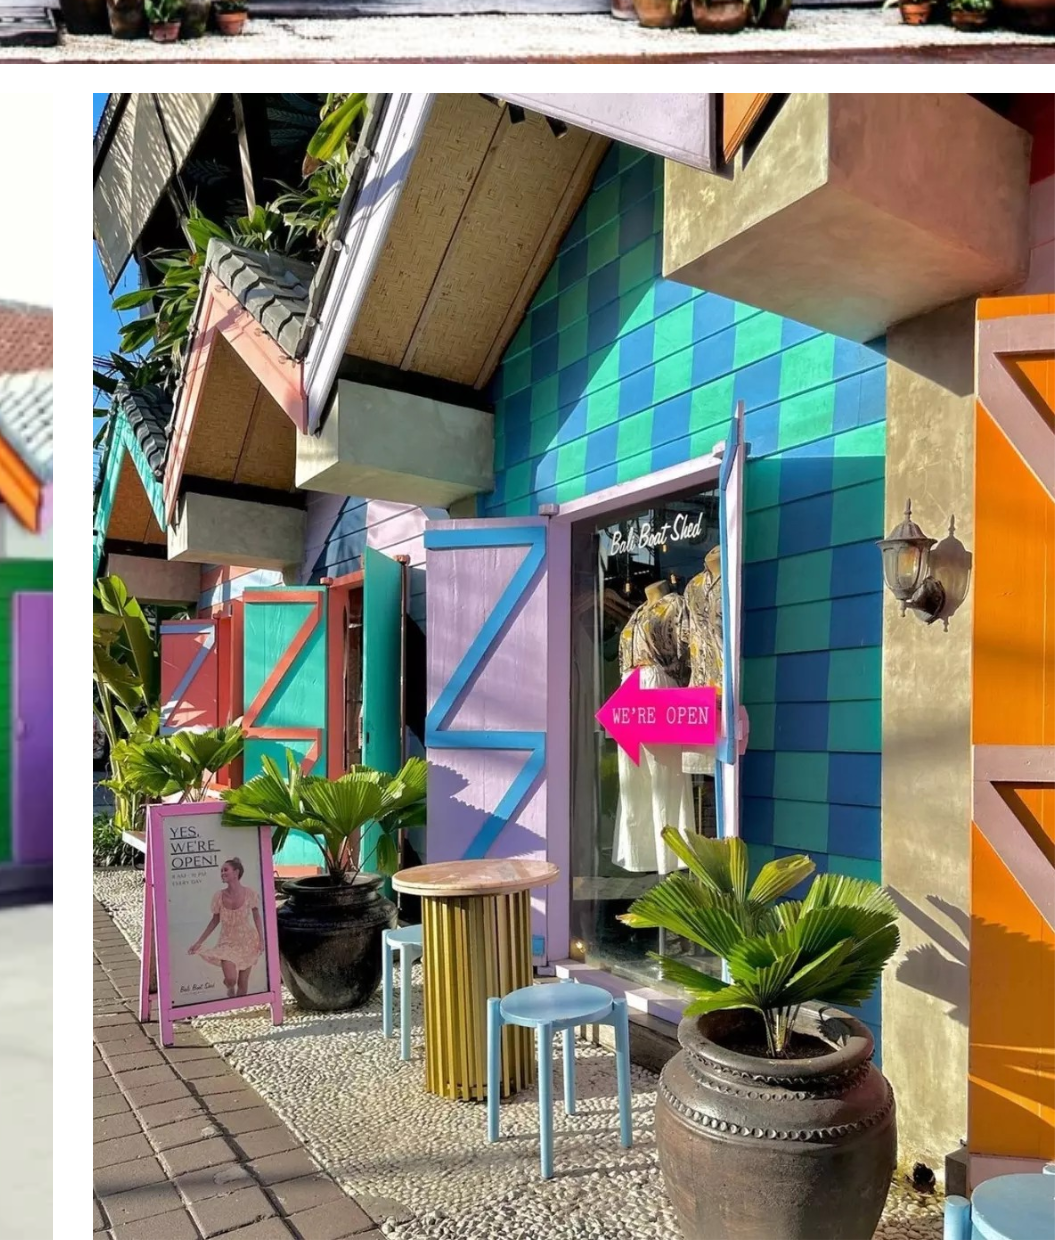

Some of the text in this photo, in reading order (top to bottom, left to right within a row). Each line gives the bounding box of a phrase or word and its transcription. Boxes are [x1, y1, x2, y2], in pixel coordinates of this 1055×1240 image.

[610, 511, 704, 556] Bali Boat Shed
[612, 706, 709, 725] WE'RE OPEN
[169, 825, 200, 838] YES,
[170, 839, 215, 853] WE'RE
[171, 854, 217, 869] OPEN!
